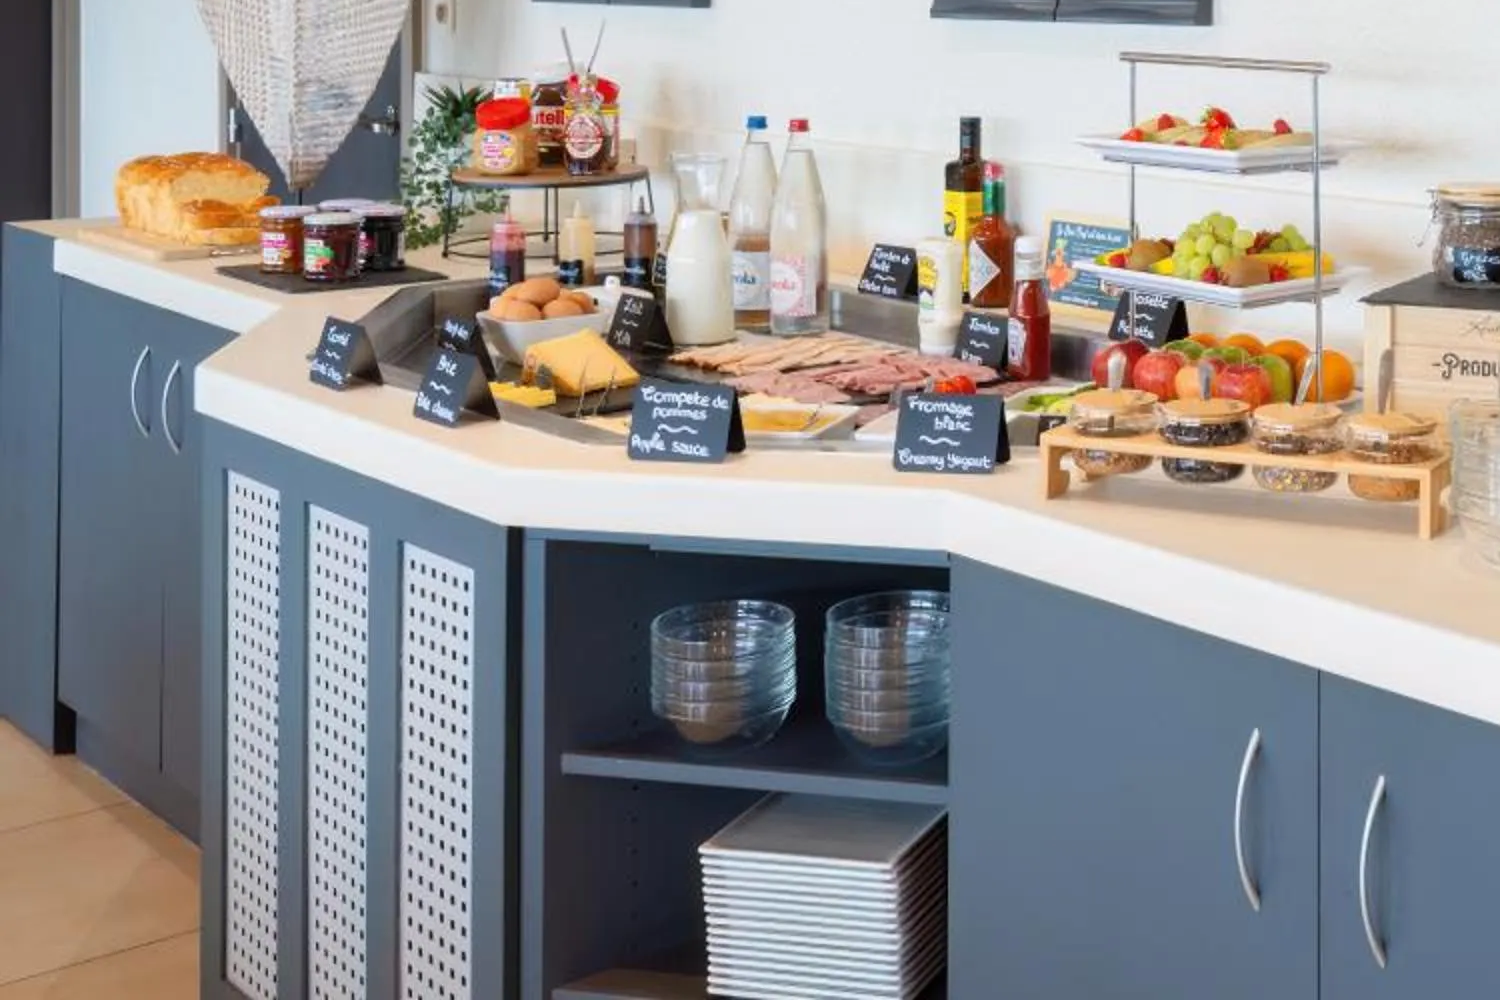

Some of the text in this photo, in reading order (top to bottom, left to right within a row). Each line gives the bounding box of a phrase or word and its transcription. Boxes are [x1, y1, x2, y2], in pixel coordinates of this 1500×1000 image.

[1134, 293, 1168, 309] osette
[712, 396, 729, 409] de
[908, 395, 973, 418] Fromage
[934, 416, 972, 431] blanc
[672, 441, 711, 457] sauce
